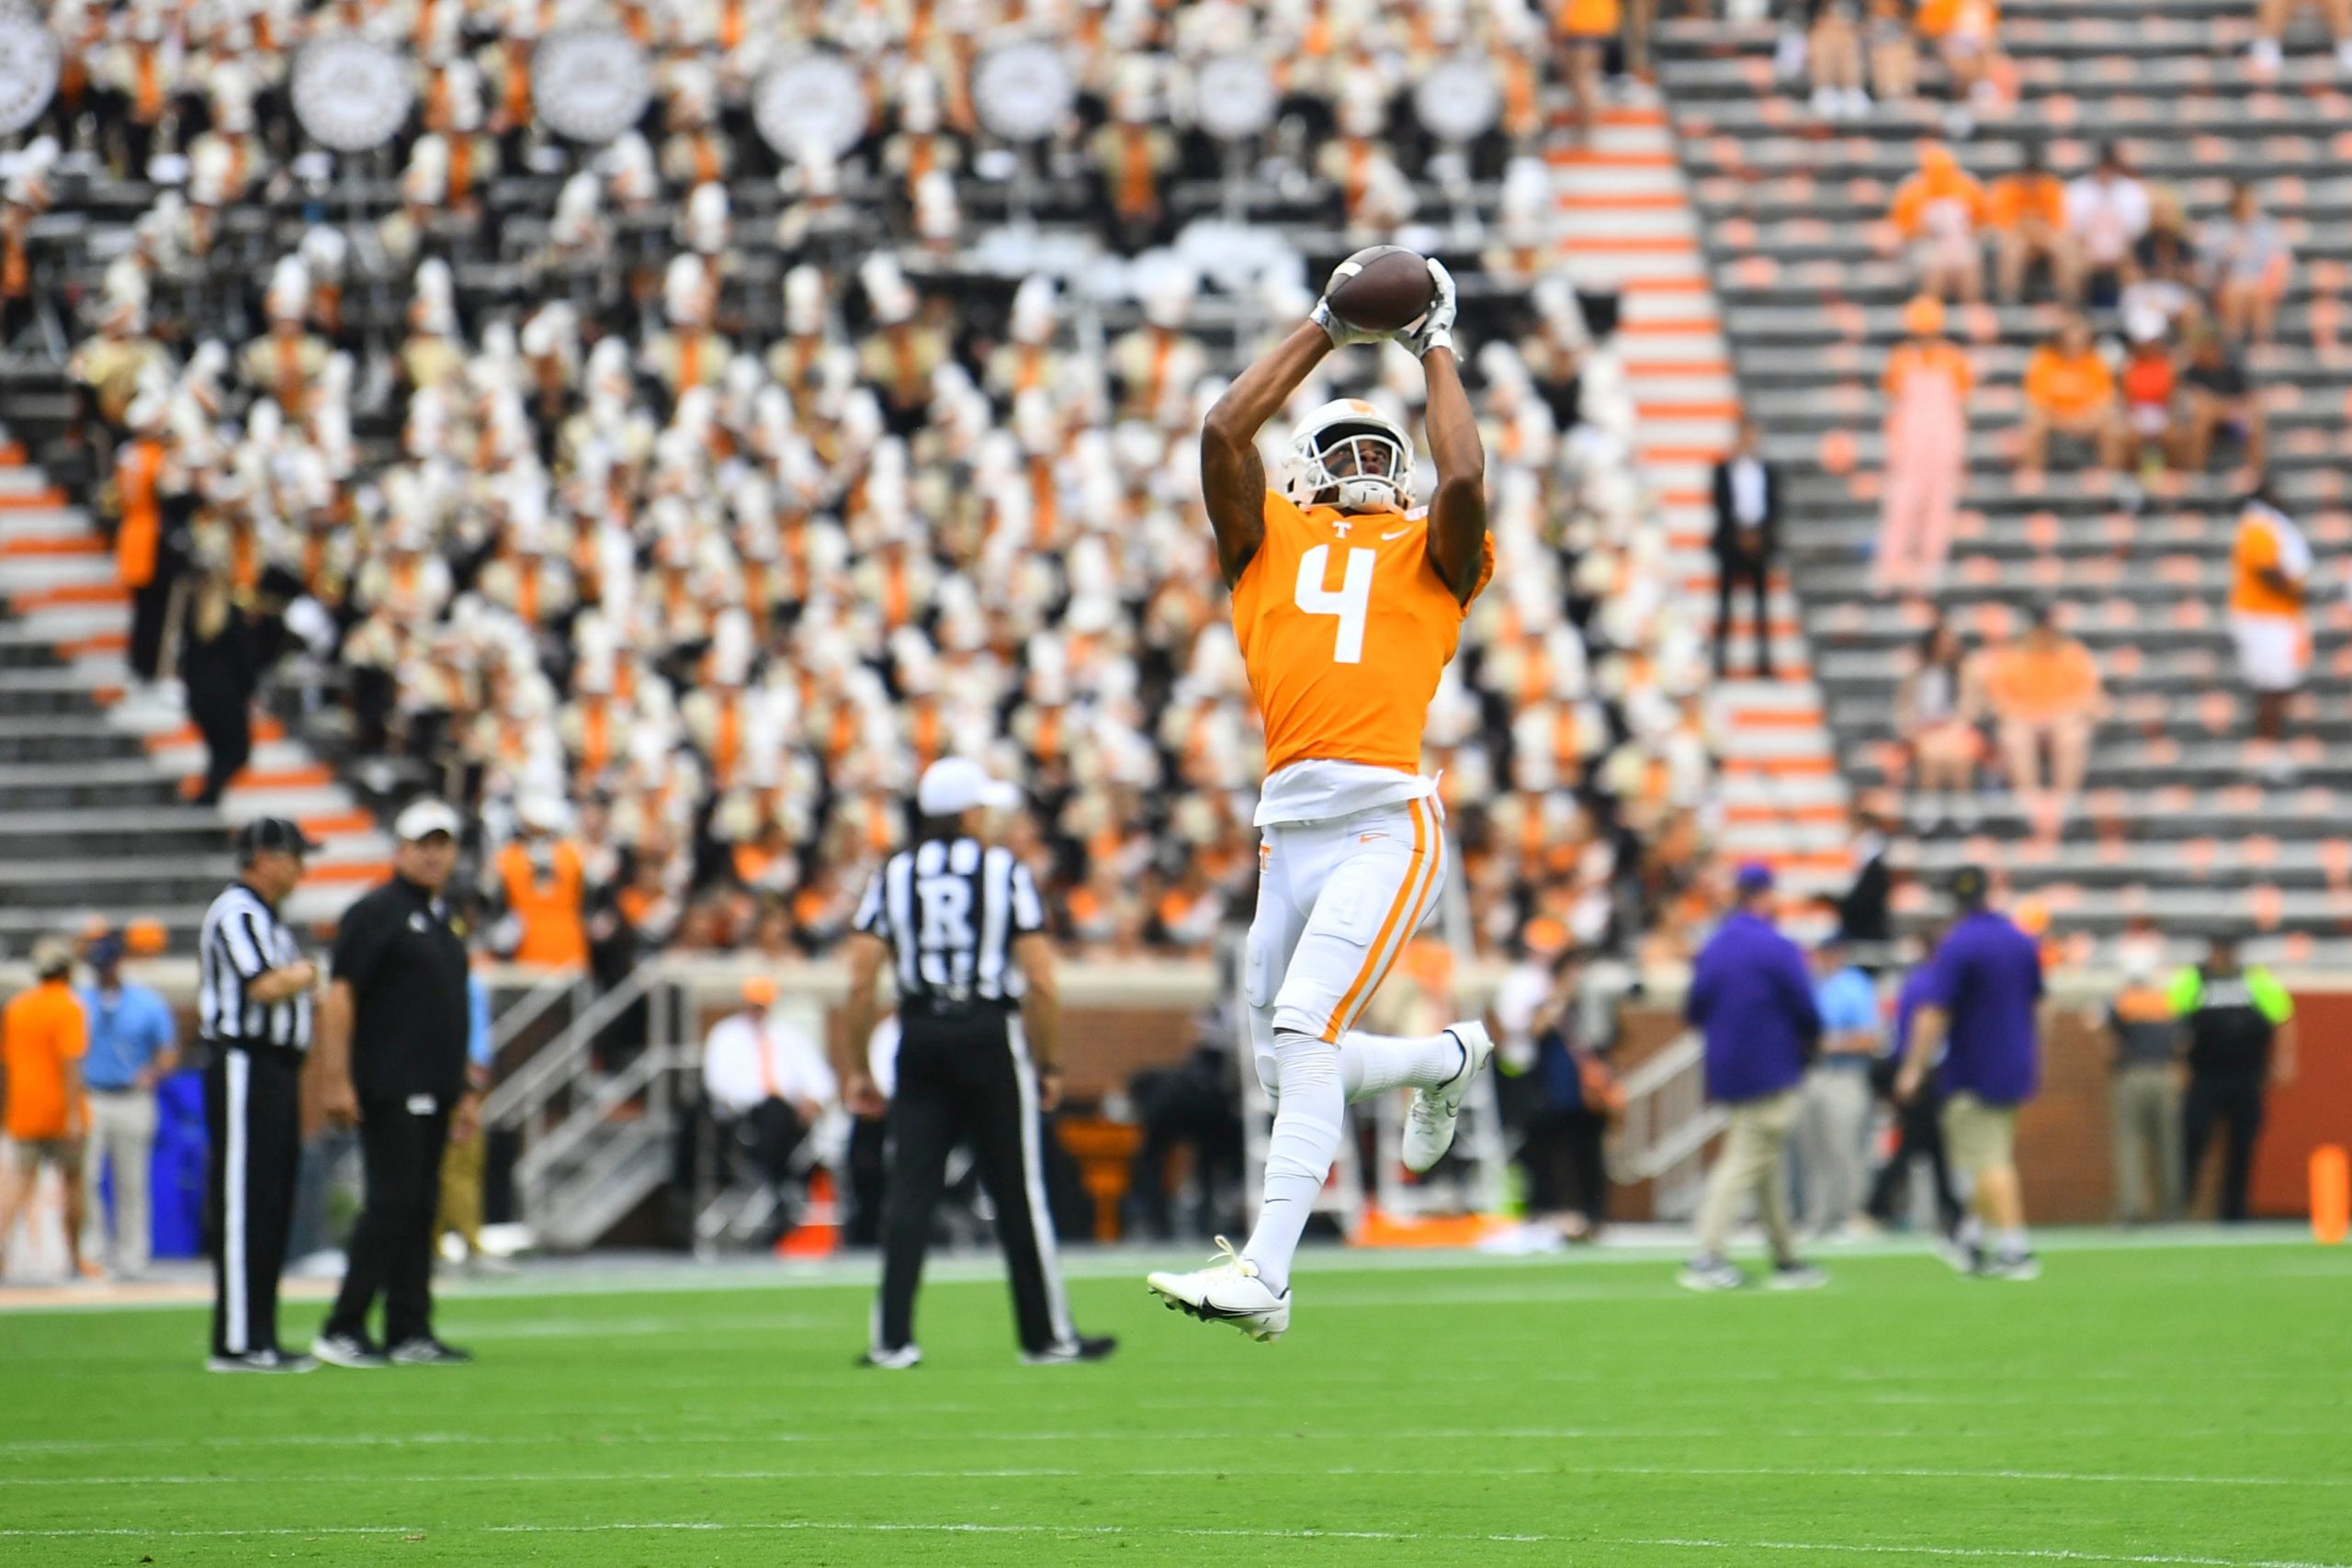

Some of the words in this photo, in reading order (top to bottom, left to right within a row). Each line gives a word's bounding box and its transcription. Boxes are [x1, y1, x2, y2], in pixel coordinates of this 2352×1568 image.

[1332, 521, 1352, 538] T
[1295, 544, 1376, 664] 4
[917, 875, 976, 950] R
